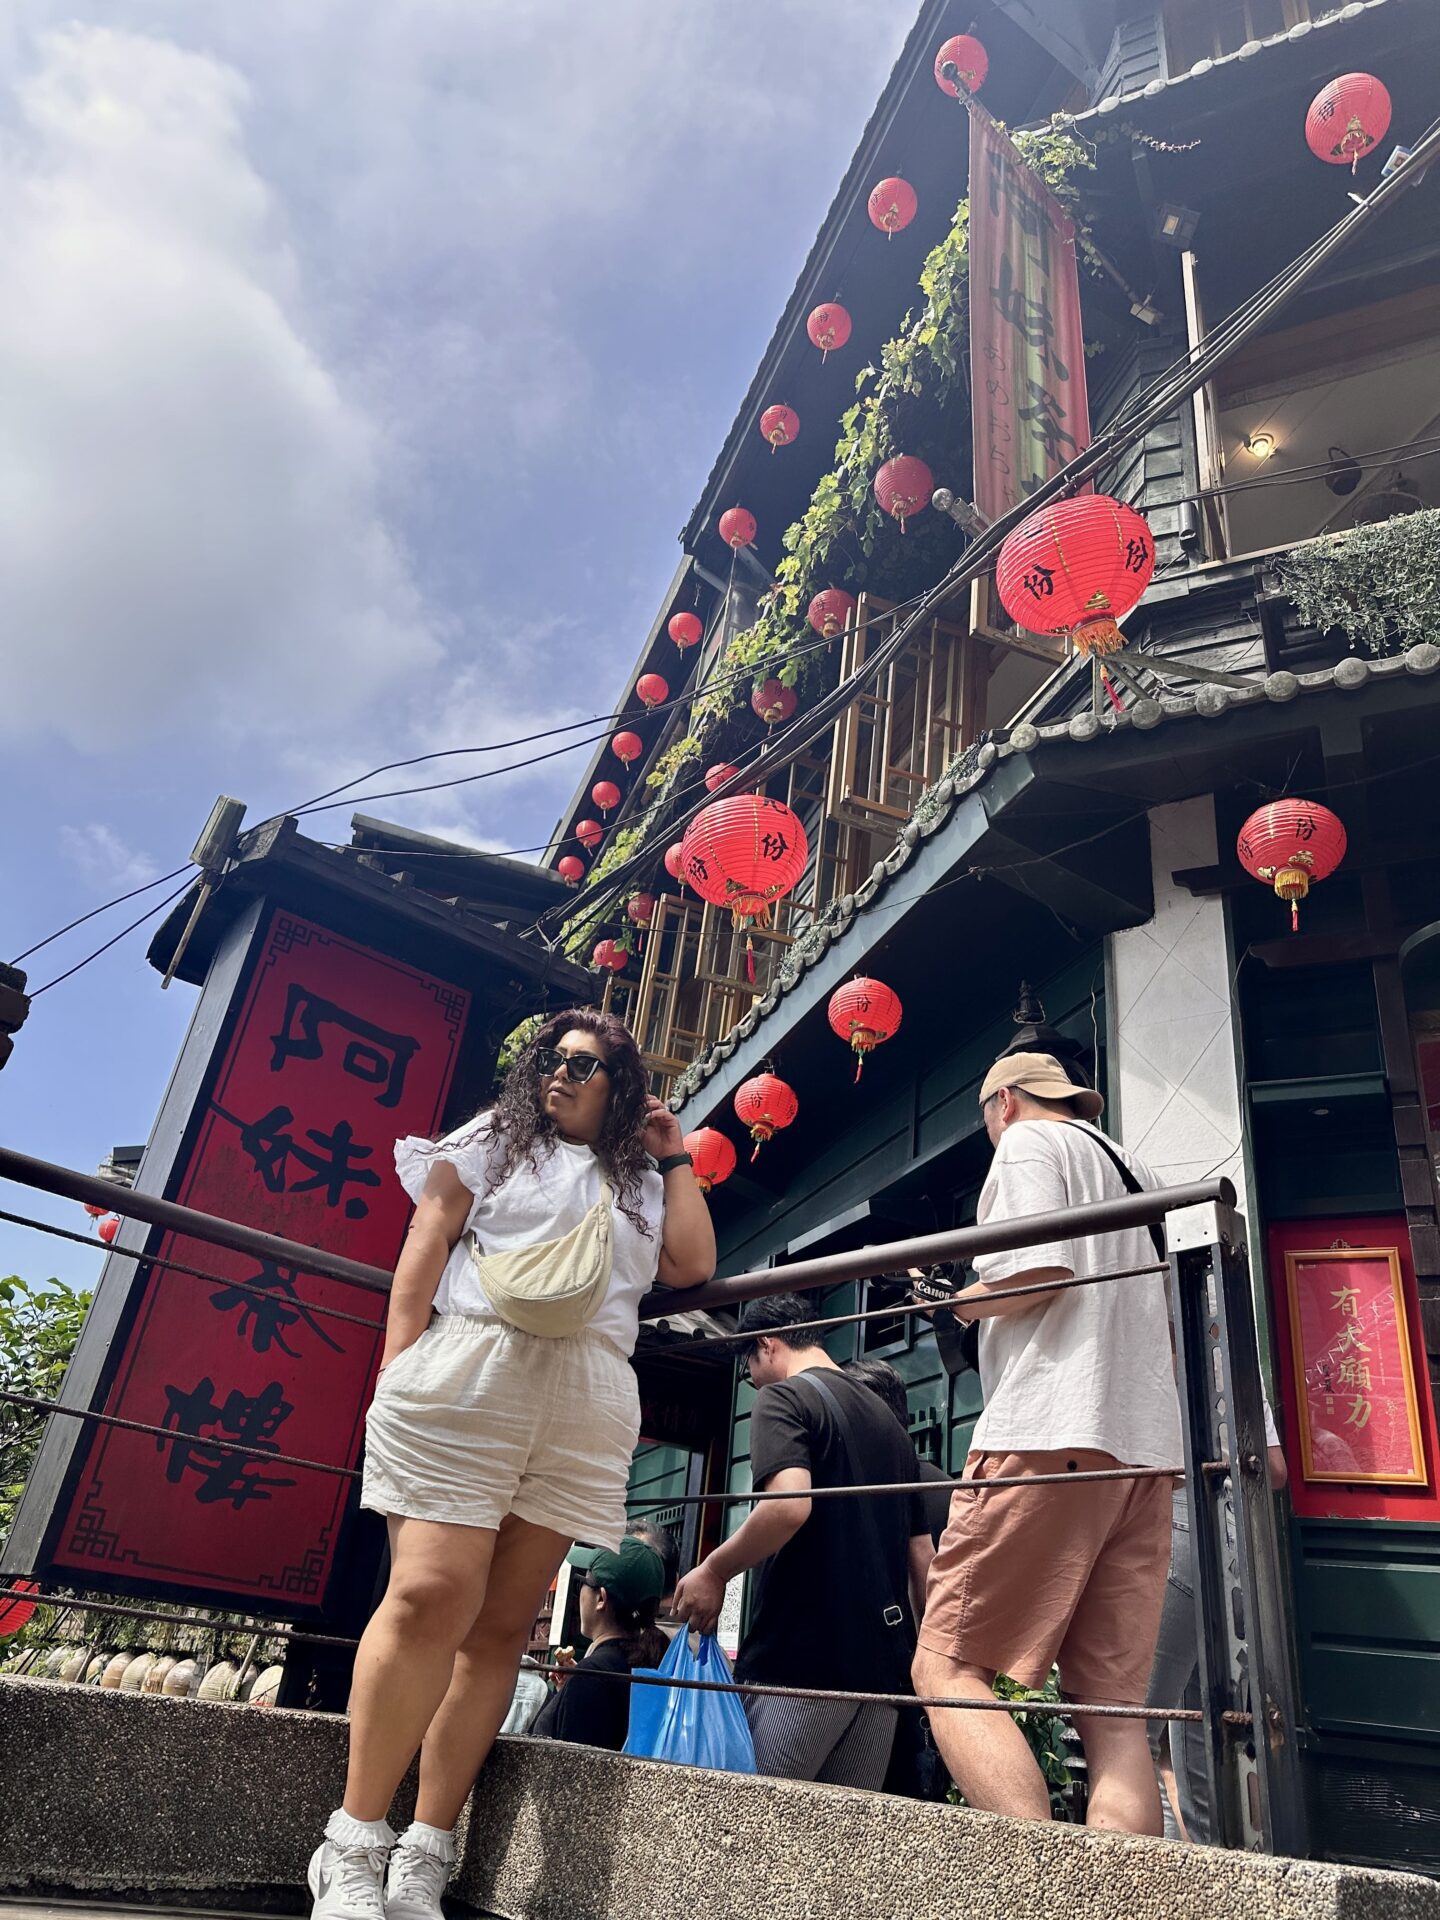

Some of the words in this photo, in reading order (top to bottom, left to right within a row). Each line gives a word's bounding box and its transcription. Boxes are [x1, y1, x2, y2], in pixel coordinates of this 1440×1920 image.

[985, 147, 1079, 497] 阿妹茶
[1125, 536, 1149, 574] 份
[1023, 563, 1056, 601] 份
[917, 1281, 951, 1301] Canon
